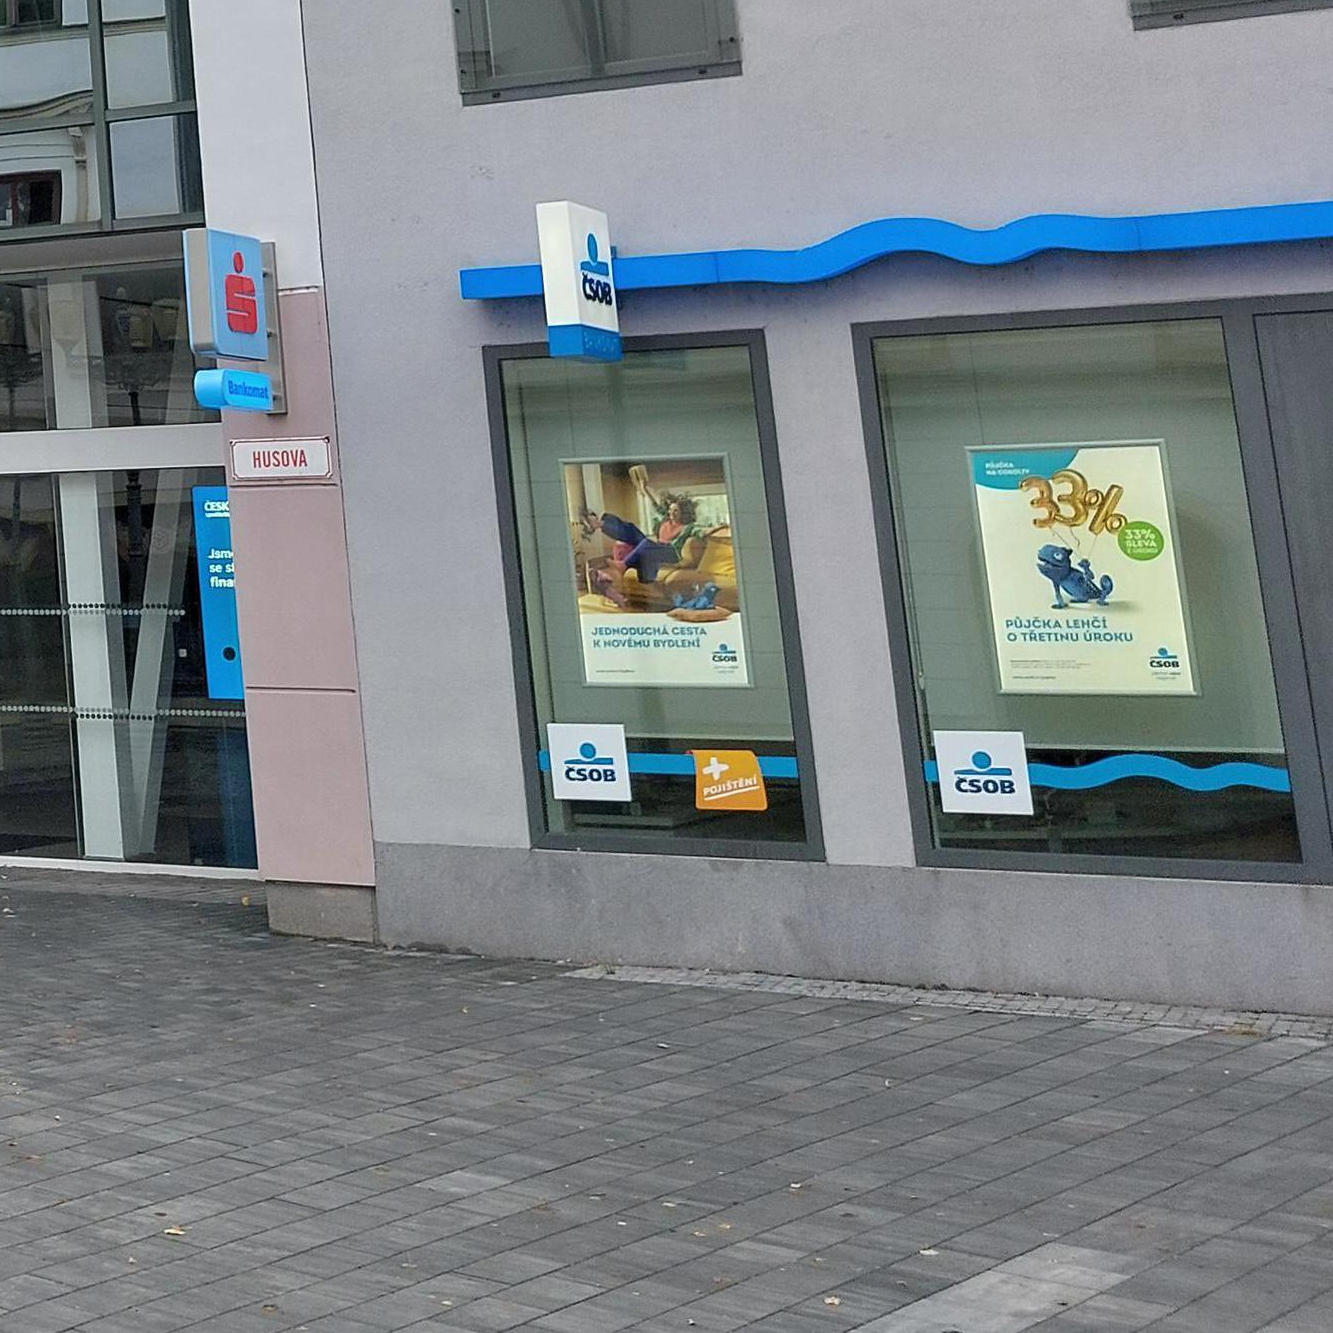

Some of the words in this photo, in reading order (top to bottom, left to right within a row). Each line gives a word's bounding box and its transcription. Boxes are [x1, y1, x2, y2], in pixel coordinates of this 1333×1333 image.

[581, 272, 613, 306] ČSOB
[228, 380, 269, 399] Bankomat
[253, 449, 308, 468] HUSOVA
[1019, 468, 1128, 536] 33%
[1124, 529, 1155, 540] 33%
[1005, 617, 1062, 629] PŮJČKA
[1066, 616, 1108, 629] LEHČÍ
[591, 626, 669, 636] JEDNODUCHÁ
[671, 626, 707, 636] CESTA
[1007, 632, 1017, 642] O
[1021, 630, 1079, 642] TŘETINU
[1084, 630, 1133, 642] ÚROKU
[593, 639, 601, 648] K
[603, 638, 650, 648] NOVÉMU
[653, 638, 701, 648] BYDLENÍ
[712, 654, 738, 663] ČSOB
[1149, 659, 1180, 668] ČSOB
[564, 766, 616, 782] ČSOB
[702, 774, 758, 797] POJIŠTĚNÍ
[955, 776, 1016, 794] ČSOB
